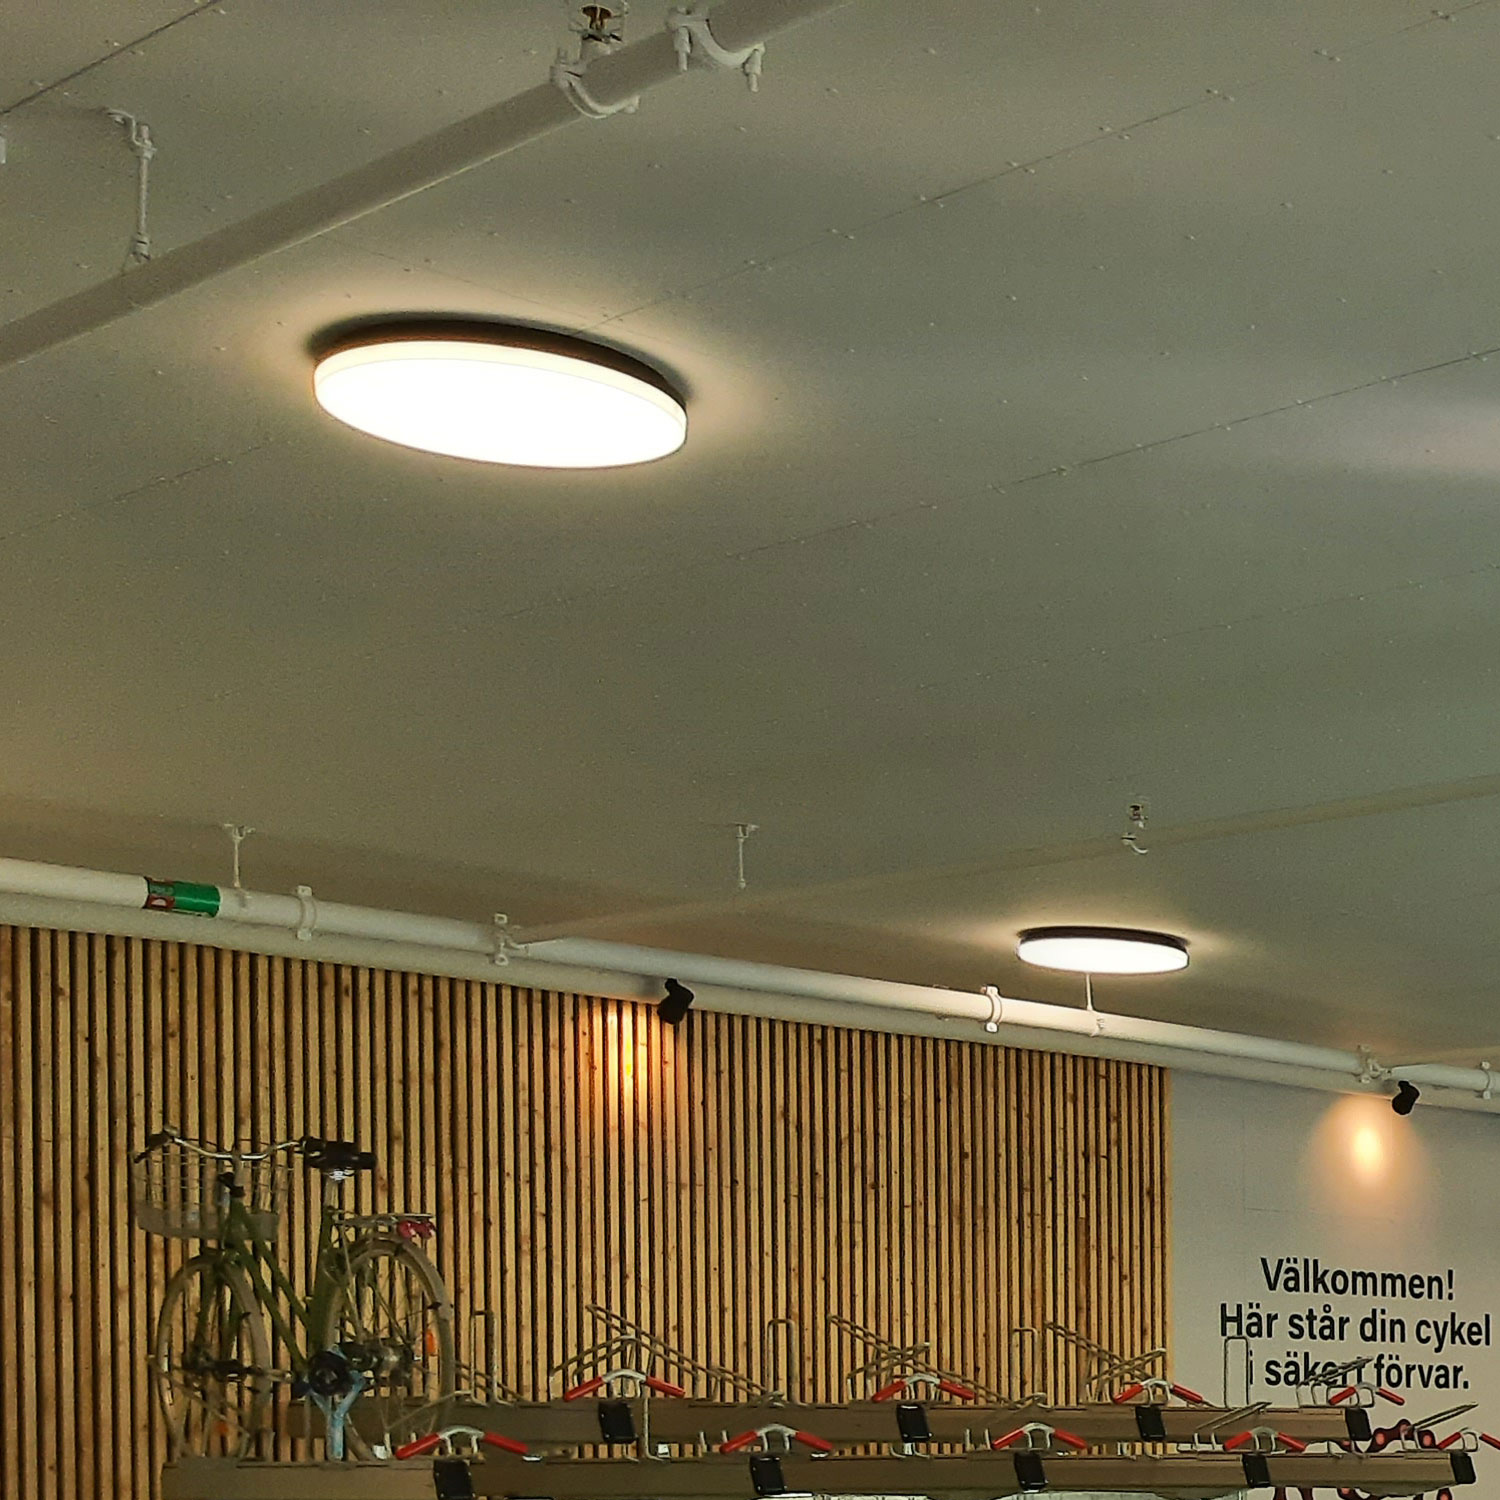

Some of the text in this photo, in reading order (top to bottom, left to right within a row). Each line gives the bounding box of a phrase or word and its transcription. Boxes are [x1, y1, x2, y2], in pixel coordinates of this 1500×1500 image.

[1260, 1257, 1454, 1300] Välkommen!
[1220, 1302, 1491, 1353] Här står din cykel
[1373, 1354, 1469, 1389] förvar.
